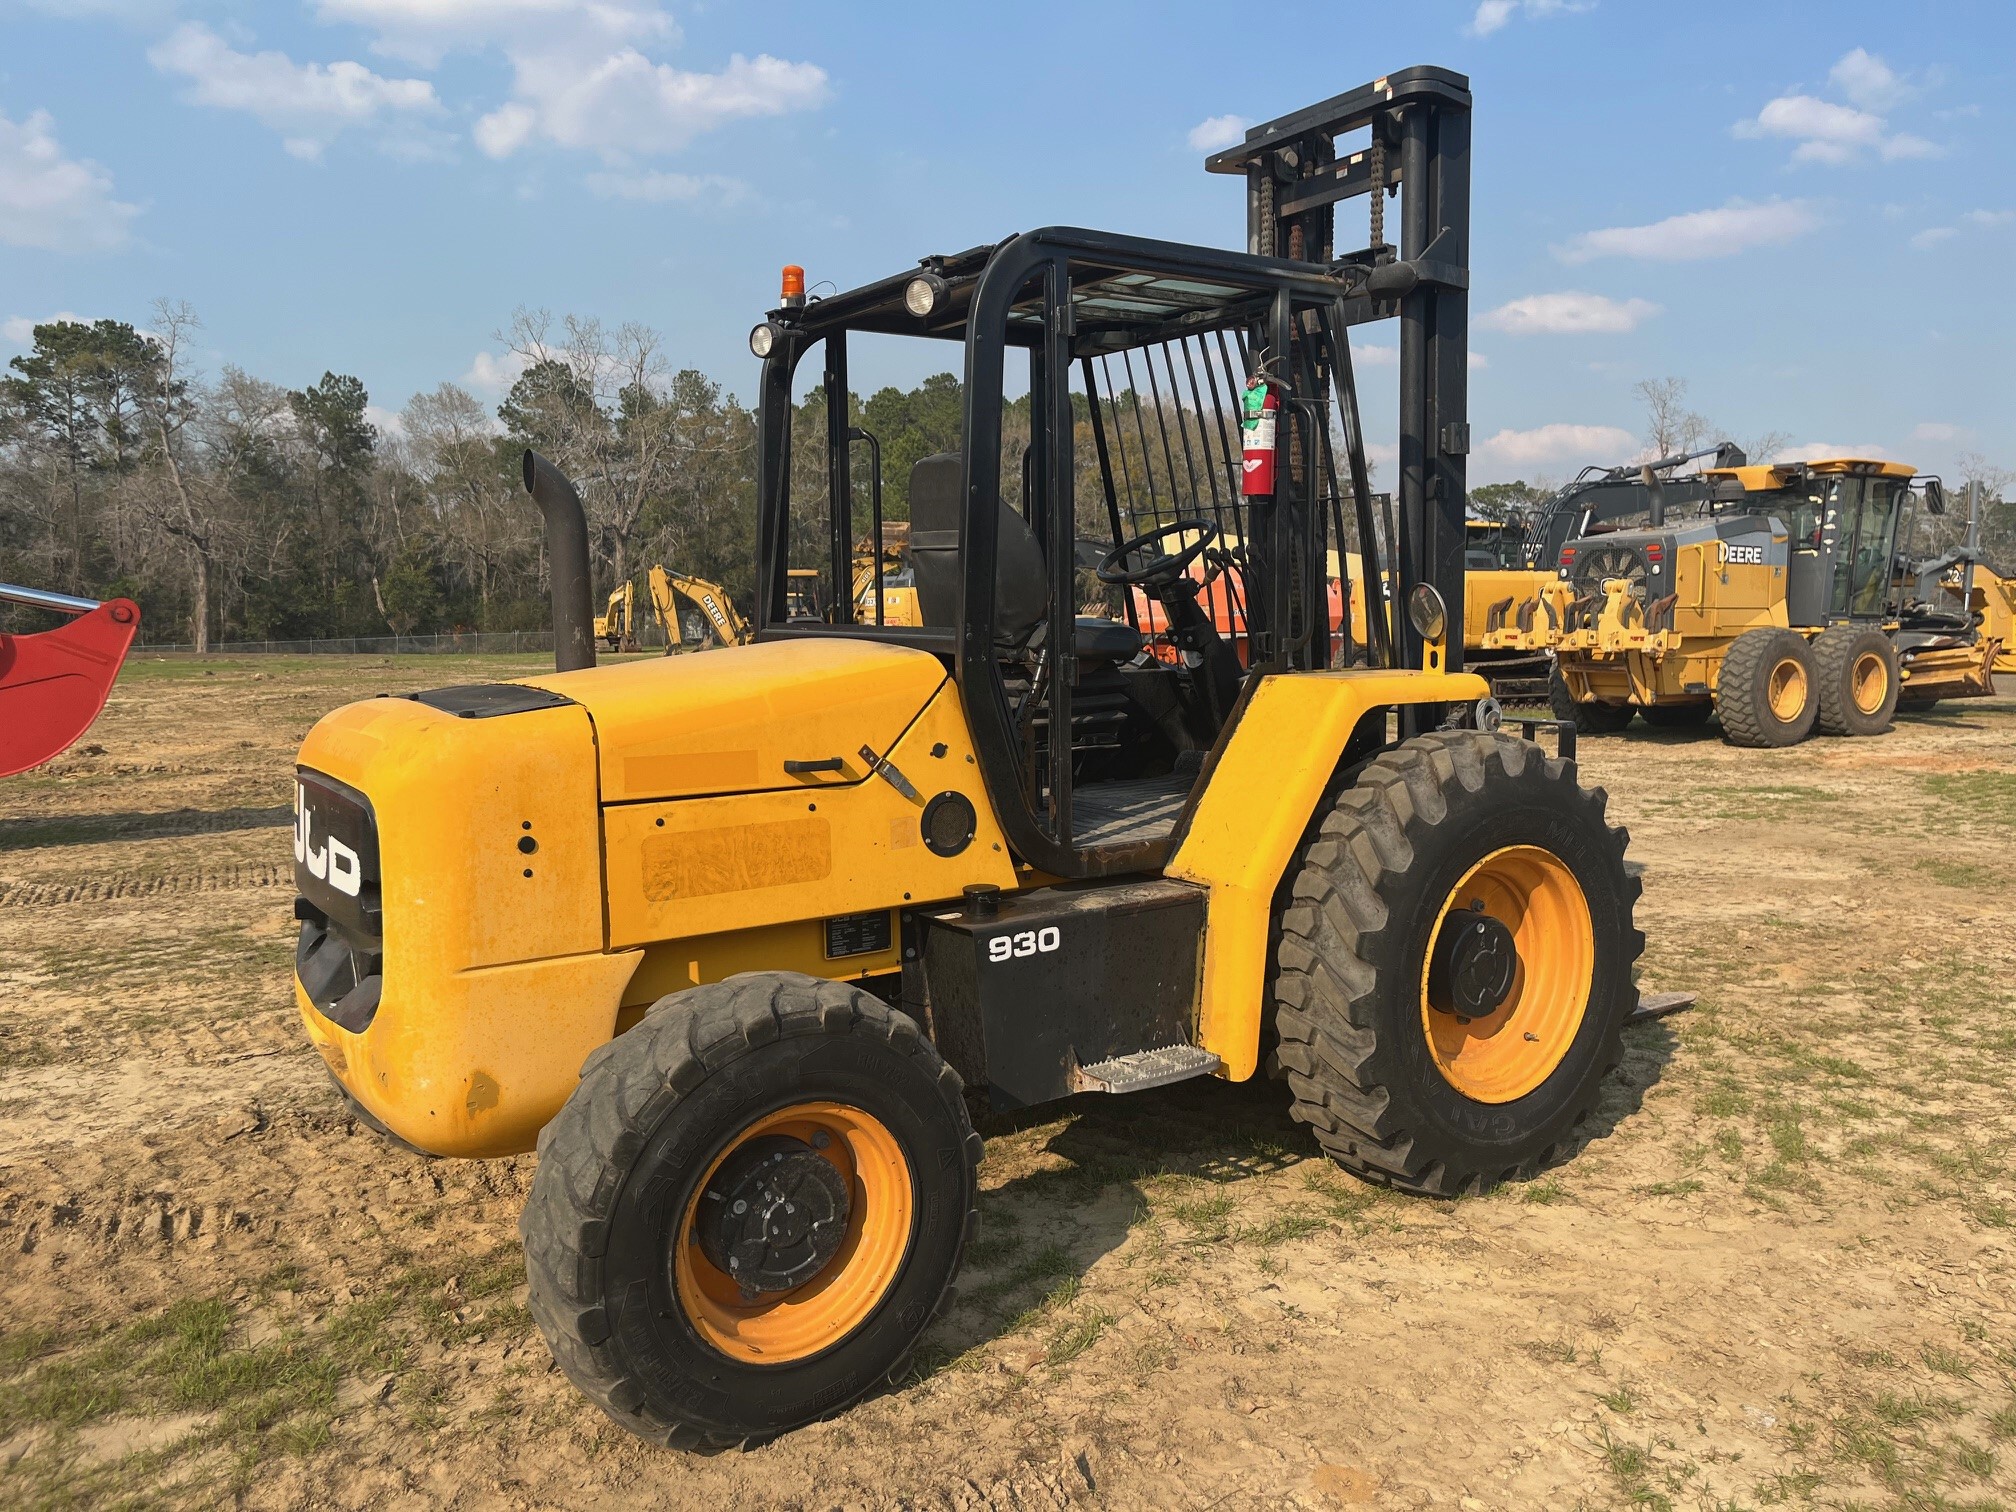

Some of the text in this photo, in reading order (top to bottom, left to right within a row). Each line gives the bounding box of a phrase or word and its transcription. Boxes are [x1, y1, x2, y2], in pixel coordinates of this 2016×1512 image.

[1719, 541, 1762, 564] DEERE
[702, 594, 726, 627] DEERE
[988, 926, 1060, 962] 930
